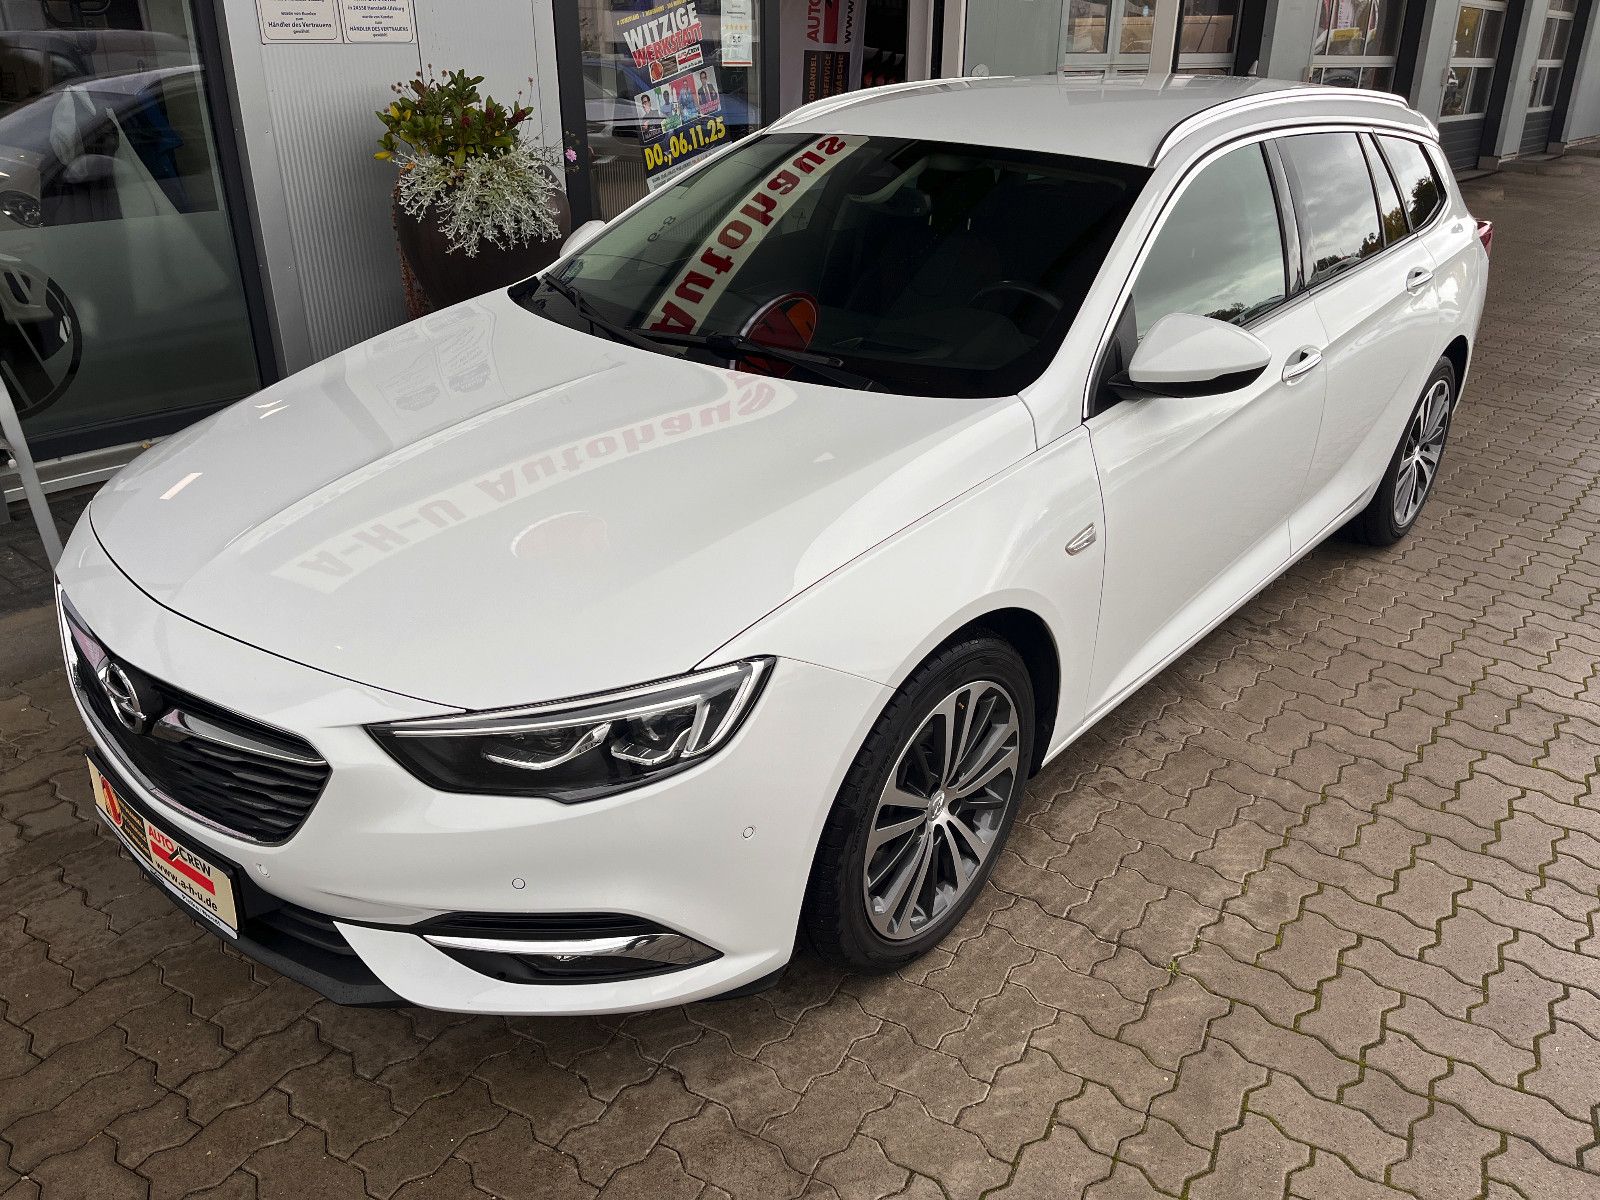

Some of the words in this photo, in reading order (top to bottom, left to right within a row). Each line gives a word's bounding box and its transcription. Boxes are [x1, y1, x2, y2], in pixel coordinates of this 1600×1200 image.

[623, 2, 700, 51] WITZIGE
[631, 22, 703, 69] WERKSTATT
[148, 825, 175, 852] AUTO
[179, 847, 211, 877] CREW
[155, 861, 218, 912] www.a-h-u.de
